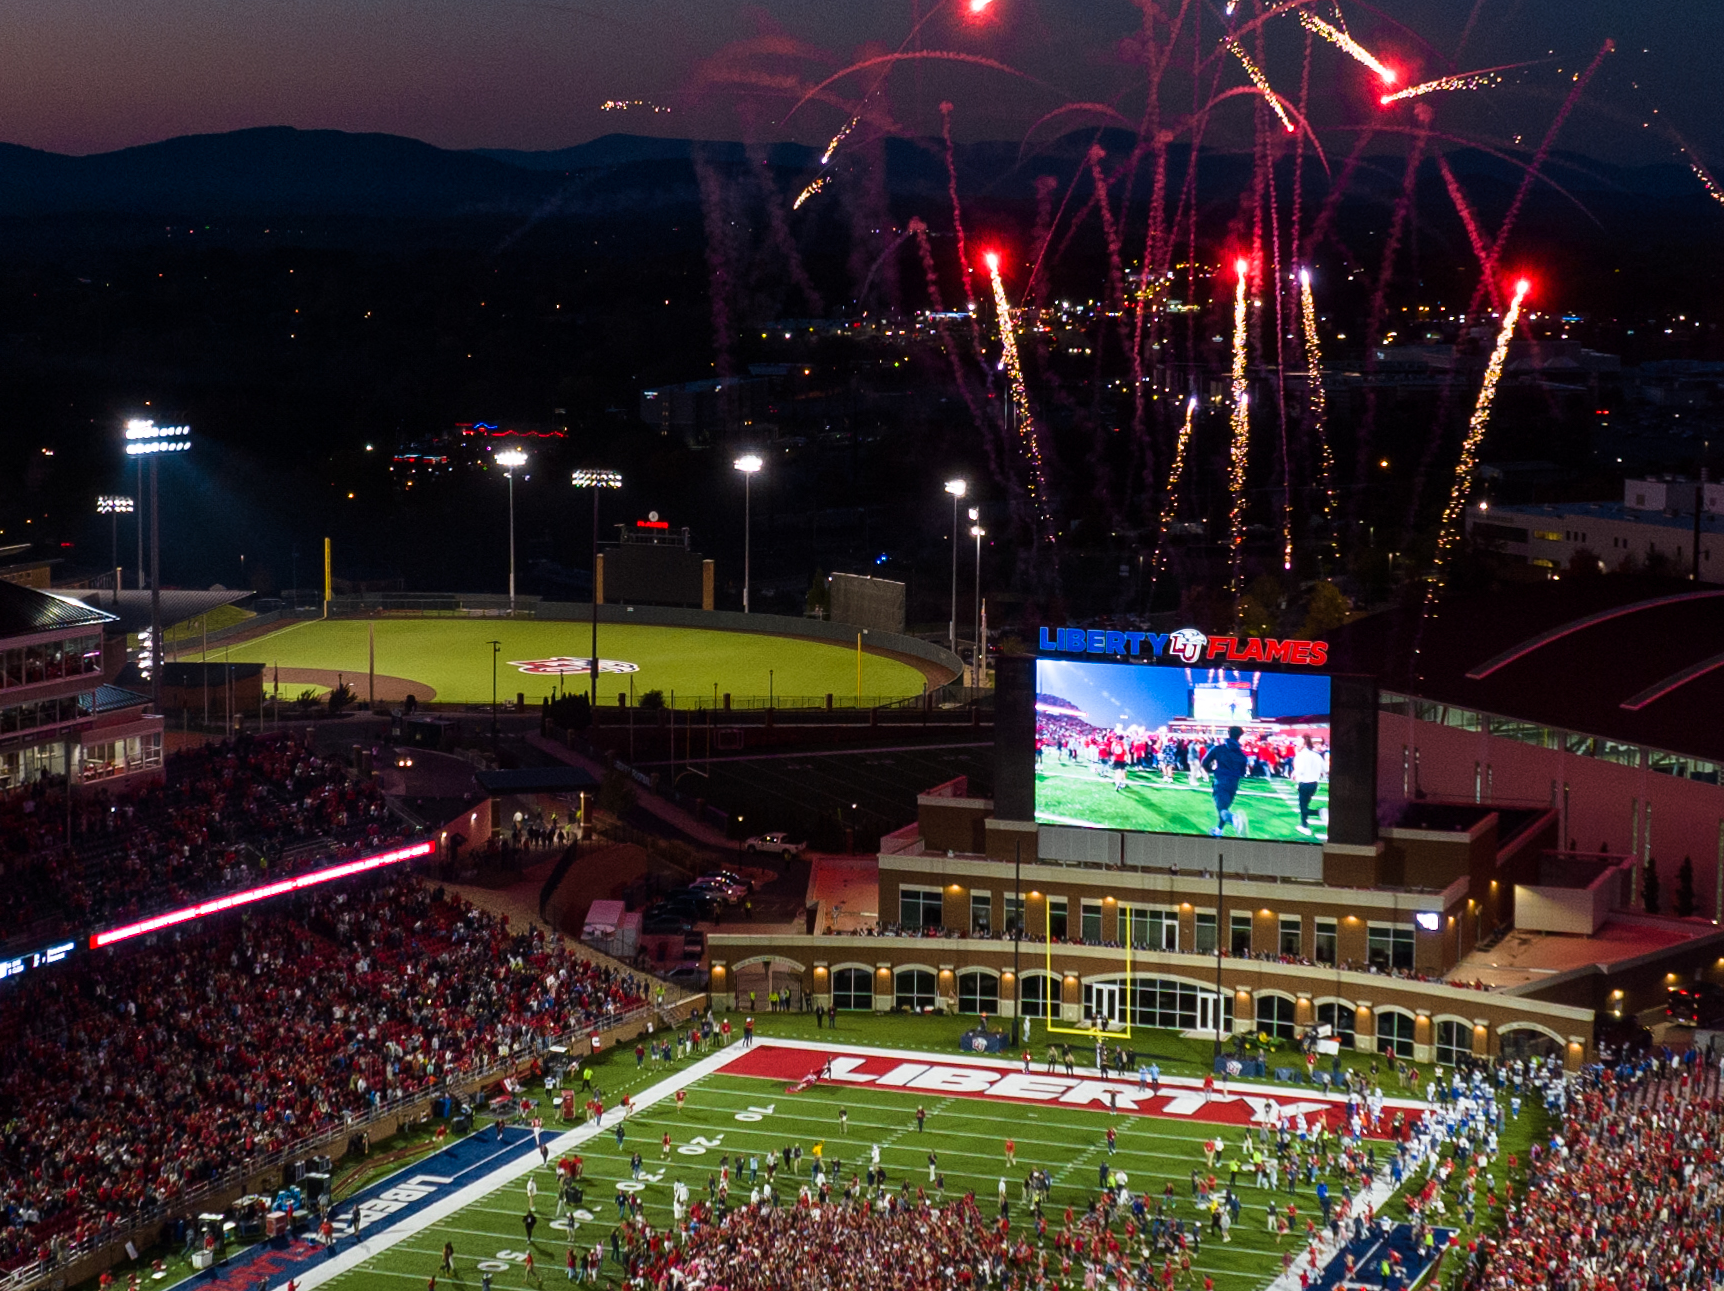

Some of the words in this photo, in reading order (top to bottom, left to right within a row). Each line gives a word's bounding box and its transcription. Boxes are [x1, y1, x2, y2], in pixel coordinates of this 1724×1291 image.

[1039, 627, 1169, 656] LIBERTY
[1206, 636, 1329, 666] FLAMES
[829, 1055, 1335, 1125] LIBERTY
